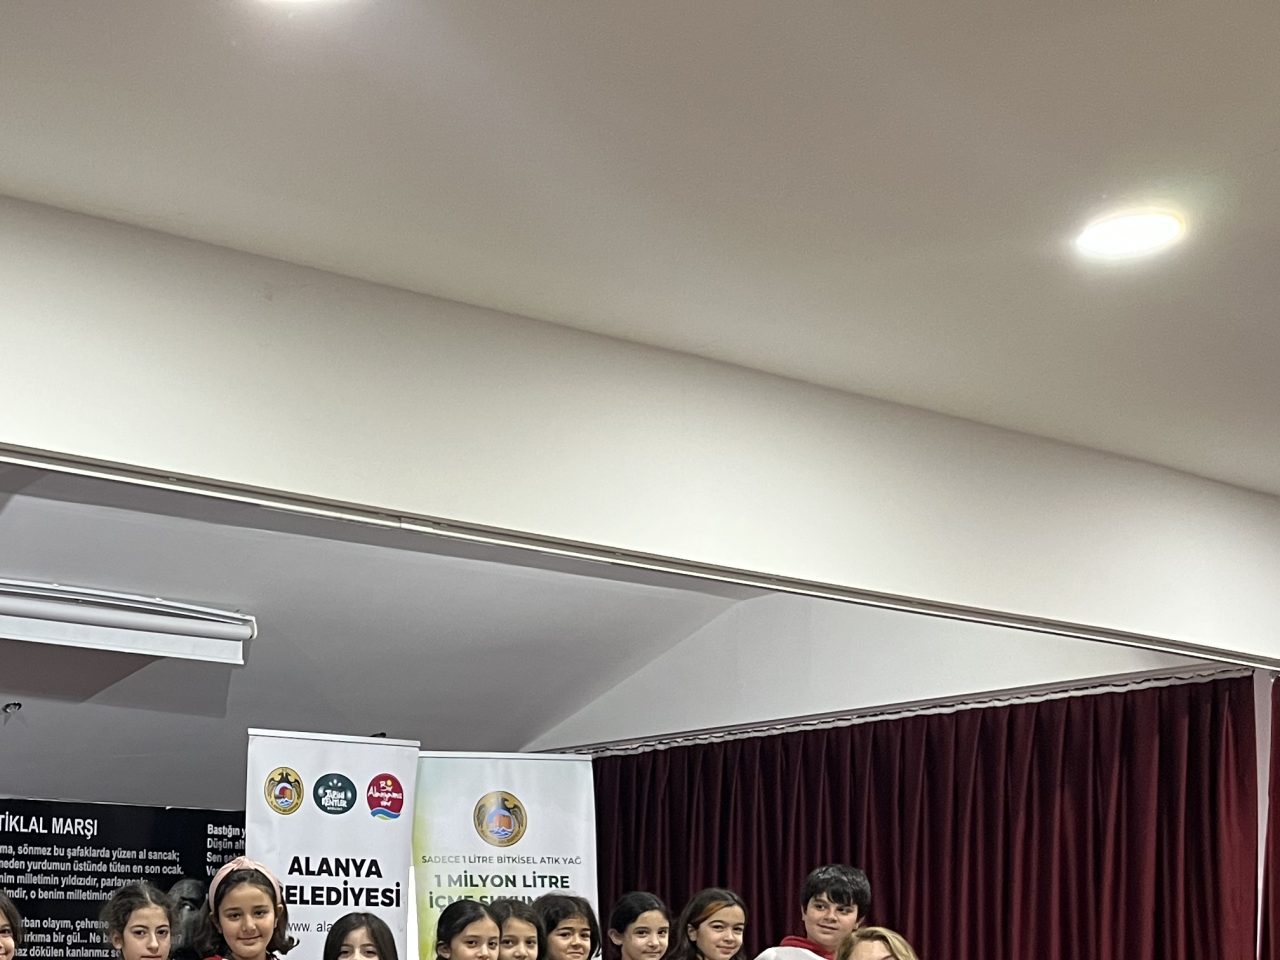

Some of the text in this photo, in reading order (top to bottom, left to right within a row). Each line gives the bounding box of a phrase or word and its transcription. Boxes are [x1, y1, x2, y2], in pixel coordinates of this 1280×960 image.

[51, 817, 98, 840] MARŞI
[207, 823, 240, 838] Bastığın
[206, 838, 233, 851] Düşün
[17, 844, 52, 856] sönmez
[53, 845, 65, 856] bu
[66, 846, 110, 859] şafaklarda
[111, 848, 137, 861] yüzen
[138, 848, 147, 860] al
[206, 851, 222, 863] Sen
[421, 855, 460, 864] SADECE
[469, 854, 494, 864] LİTRE
[496, 854, 538, 864] BİTKİSEL
[539, 856, 561, 865] ATIK
[26, 859, 72, 872] yurdumun
[72, 860, 107, 872] üstünde
[109, 861, 131, 873] tüten
[132, 864, 143, 874] en
[144, 865, 160, 874] son
[161, 865, 184, 875] ocak.
[288, 856, 383, 878] ALANYA
[16, 873, 59, 885] milletimin
[60, 874, 99, 888] yıldızıdır,
[434, 870, 570, 889] 1 MİLYON LİTRE
[30, 890, 36, 899] o
[38, 888, 65, 900] benim
[284, 880, 400, 907] ELEDİYESİ
[21, 917, 41, 928] rban
[42, 917, 73, 931] olayım,
[52, 932, 65, 943] bir
[89, 932, 101, 943] Ne
[29, 946, 64, 957] dökülen
